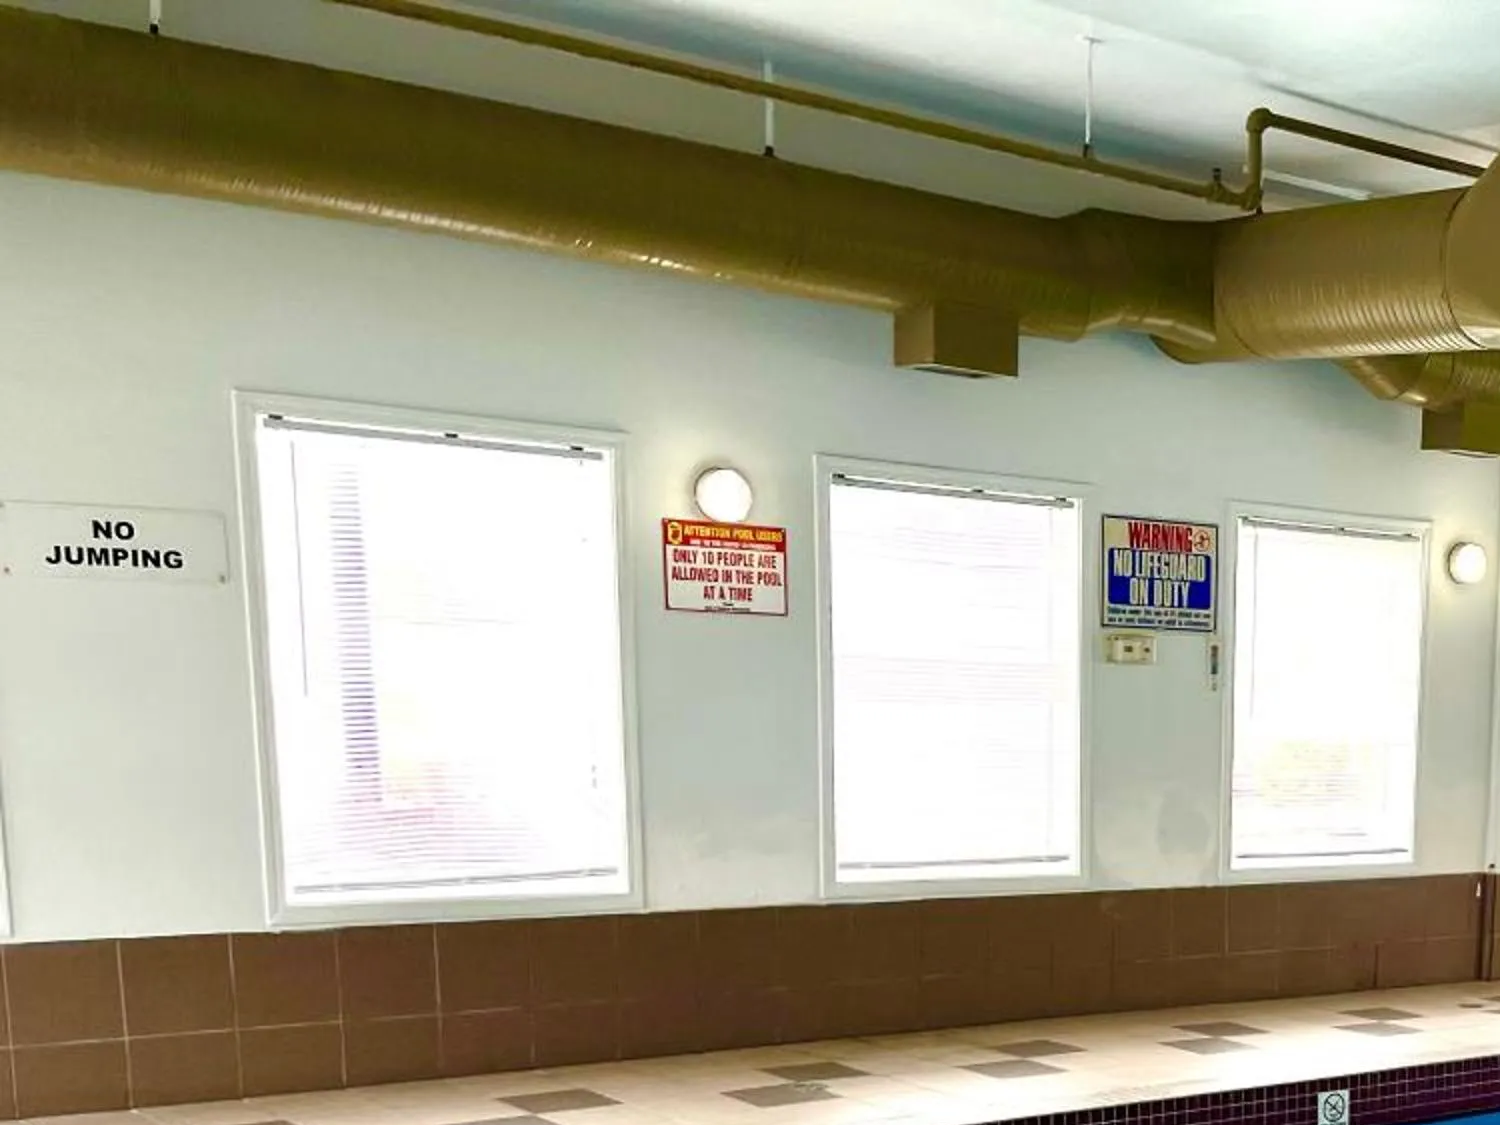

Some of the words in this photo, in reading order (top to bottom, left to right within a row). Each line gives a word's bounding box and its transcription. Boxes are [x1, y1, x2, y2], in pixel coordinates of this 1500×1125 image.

[91, 520, 135, 540] NO
[684, 525, 732, 539] ATTENTION
[1128, 522, 1193, 552] WARNING
[45, 546, 184, 569] JUMPING
[672, 549, 698, 564] ONLY
[701, 551, 714, 565] 10
[717, 551, 754, 568] PEOPLE
[757, 554, 777, 569] ARE
[1113, 550, 1133, 577] NO
[1135, 550, 1206, 582] LIFEGUARD
[671, 566, 719, 582] ALLOWED
[721, 569, 733, 583] IN
[735, 570, 755, 585] THE
[757, 571, 783, 587] POOL
[703, 586, 715, 600] AT
[718, 586, 726, 600] A
[728, 587, 753, 602] TIME
[1129, 577, 1149, 605] ON
[1153, 578, 1191, 607] DUTY
